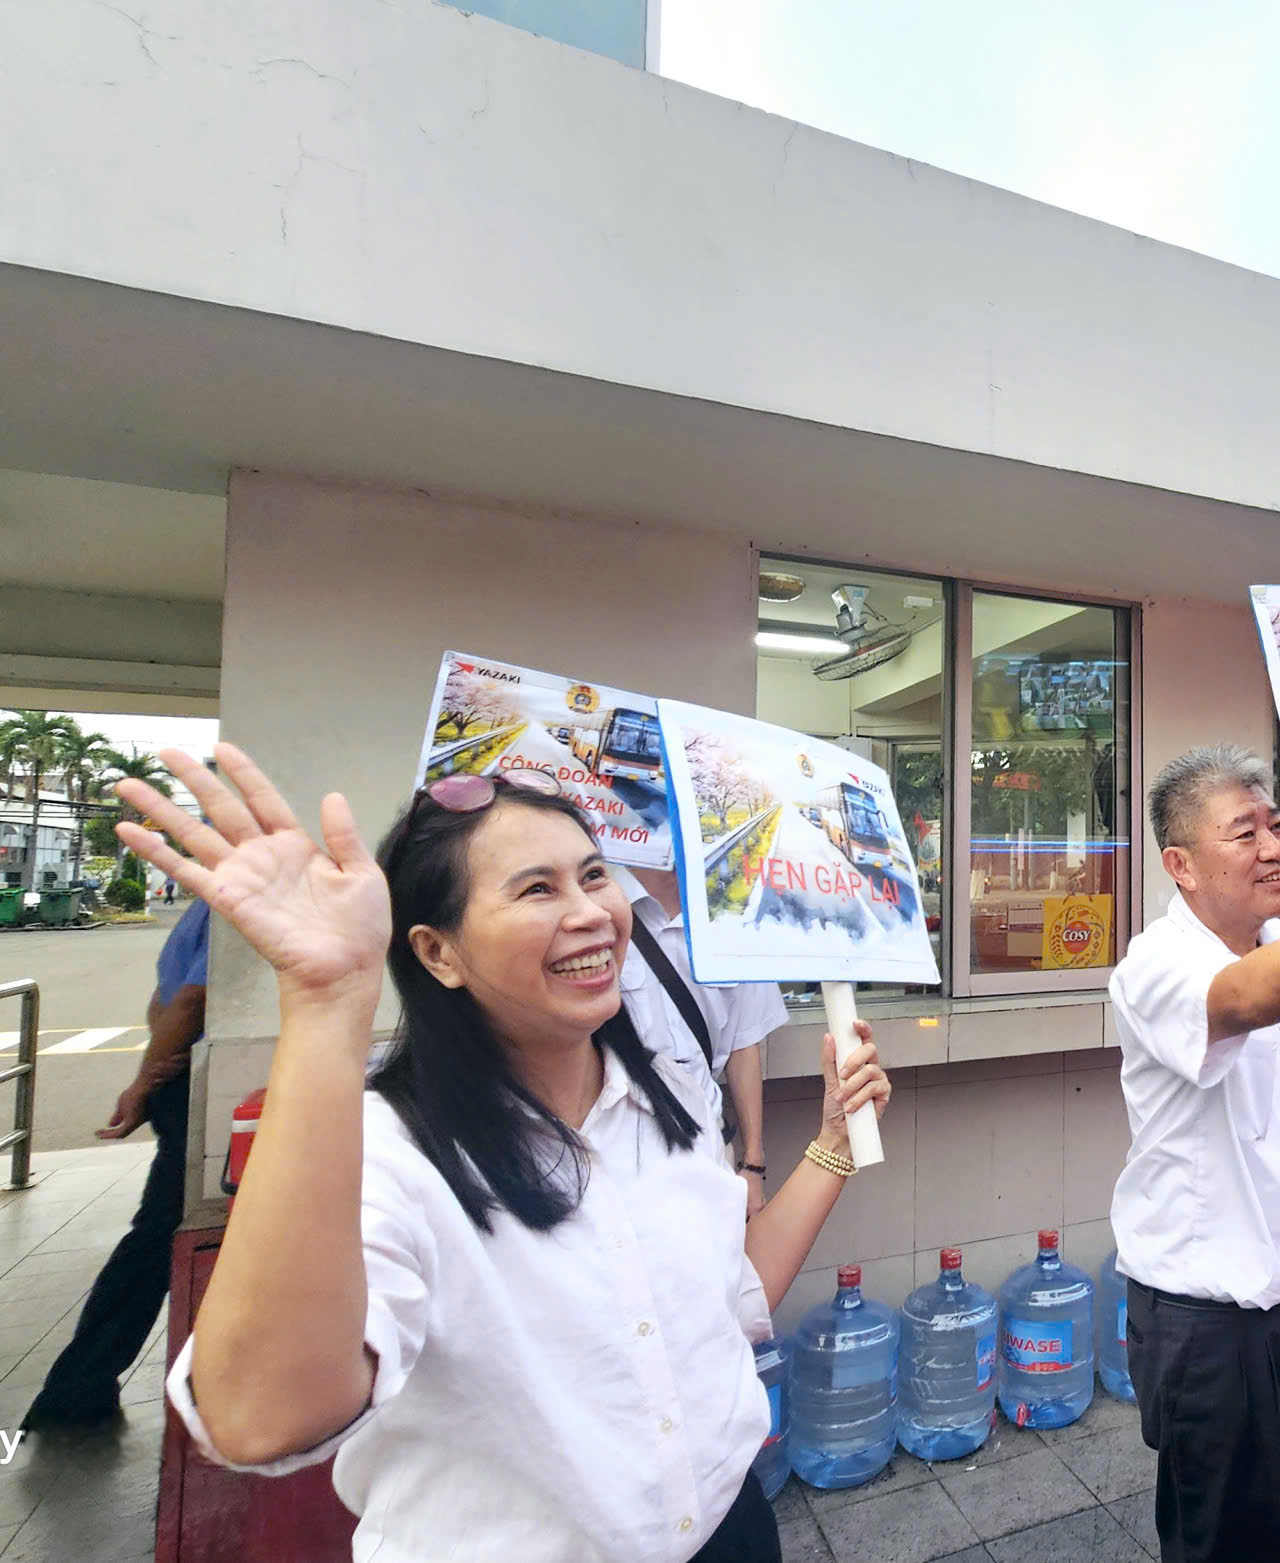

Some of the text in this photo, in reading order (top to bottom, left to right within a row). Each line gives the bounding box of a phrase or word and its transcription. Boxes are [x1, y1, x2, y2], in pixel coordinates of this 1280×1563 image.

[476, 666, 521, 685] YAZAKI
[742, 854, 900, 911] HẸN GẶP LẠI
